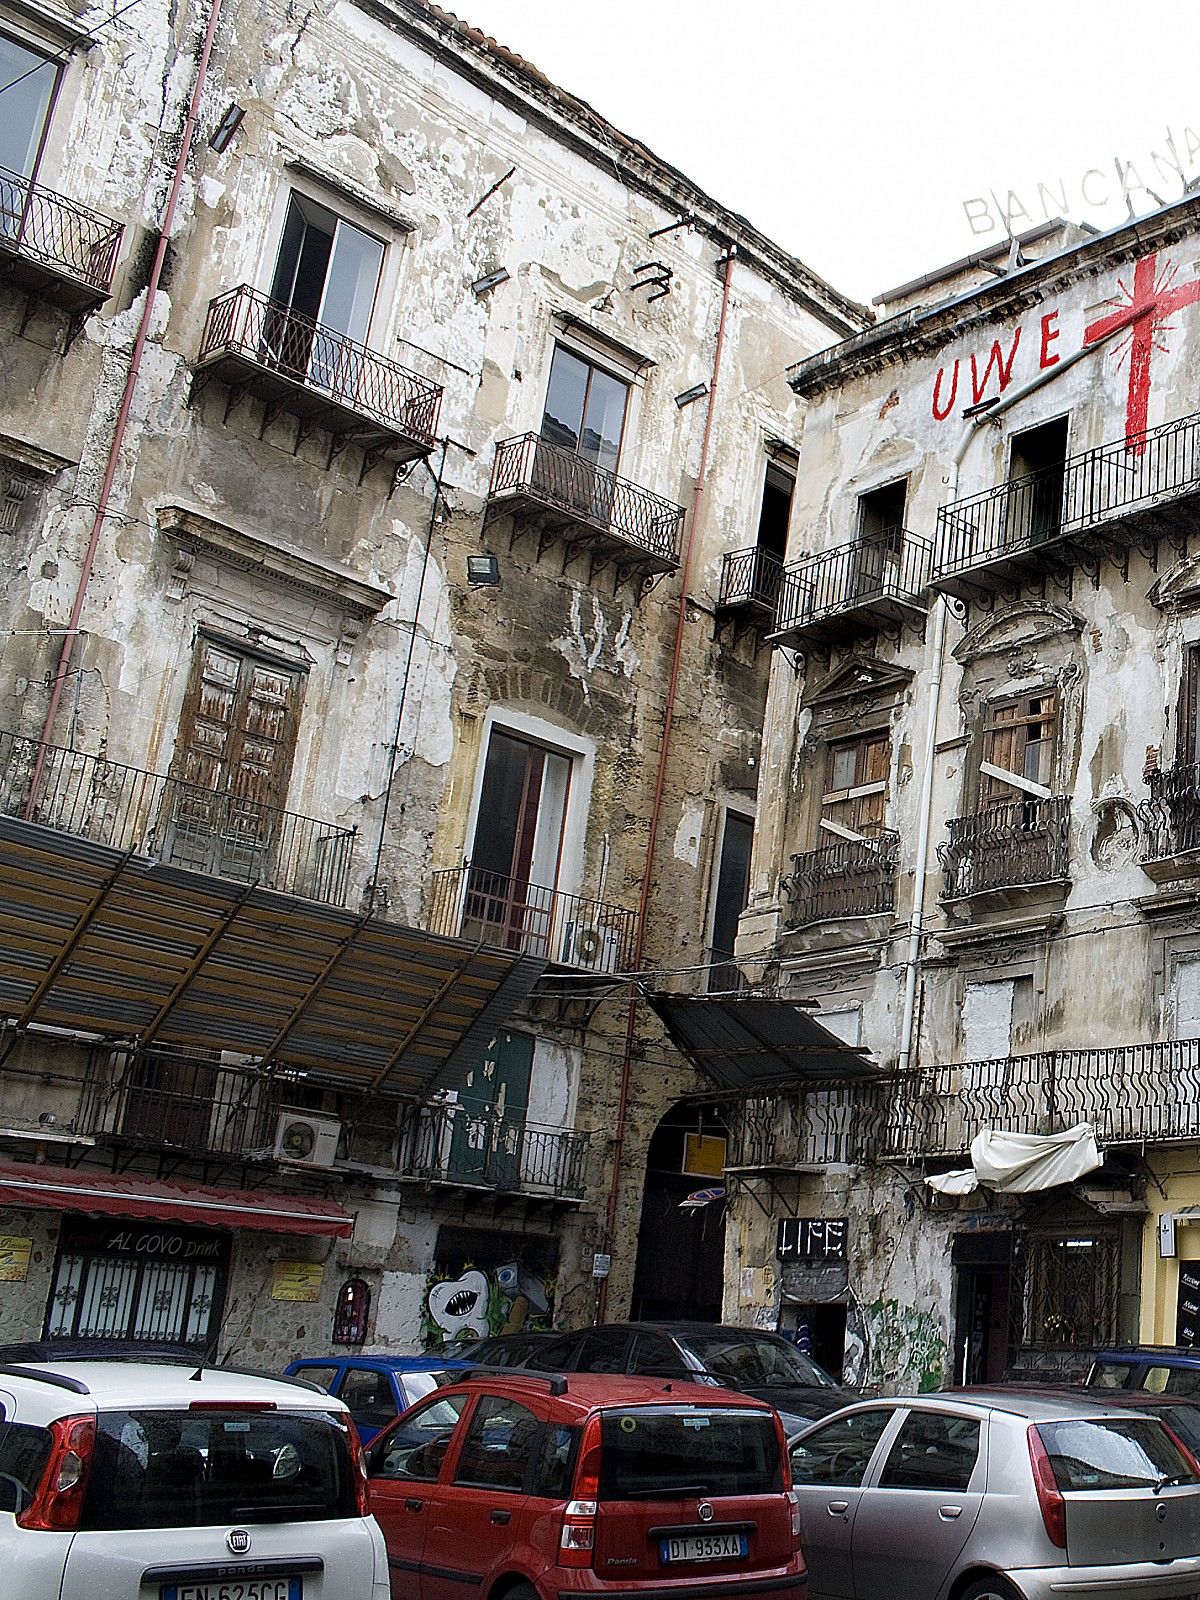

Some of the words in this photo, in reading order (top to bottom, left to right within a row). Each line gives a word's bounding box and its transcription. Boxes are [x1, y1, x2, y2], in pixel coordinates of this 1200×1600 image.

[932, 309, 1061, 421] UWE
[184, 1240, 222, 1257] Drink
[232, 1534, 247, 1547] FIAT
[671, 1539, 689, 1559] DT
[696, 1535, 739, 1557] 933XA
